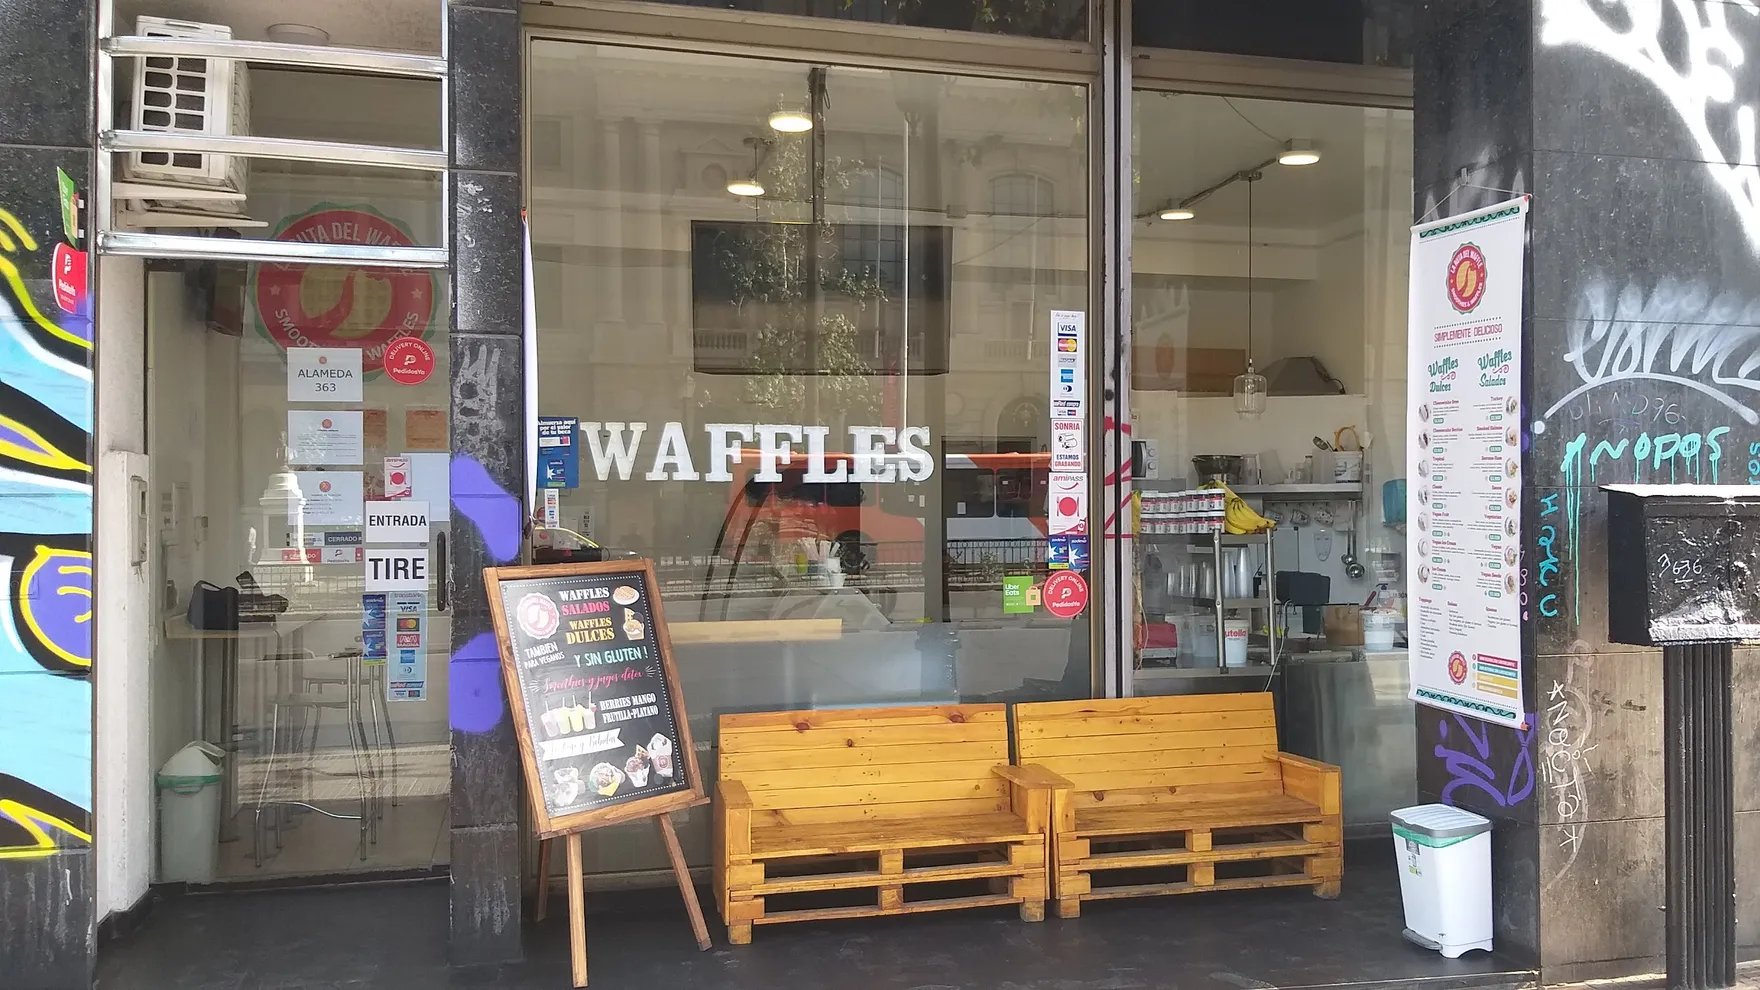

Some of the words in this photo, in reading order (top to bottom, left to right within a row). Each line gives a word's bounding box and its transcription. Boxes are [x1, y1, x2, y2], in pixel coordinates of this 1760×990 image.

[332, 222, 361, 241] DEL
[1060, 324, 1077, 332] VISA
[1433, 327, 1471, 342] SIMPLEMENTE
[1473, 323, 1503, 337] DELICIOSO
[389, 341, 412, 360] DELIVERY
[413, 342, 431, 361] ONLINE
[1477, 348, 1512, 371] Waffles
[297, 369, 353, 379] ALAMEDA
[393, 367, 425, 376] PedidosYa
[1427, 356, 1459, 378] Waffles
[315, 383, 336, 392] 363
[1429, 381, 1452, 393] Dulces
[1479, 373, 1506, 387] Salados
[1054, 422, 1081, 431] SONRIA
[580, 421, 935, 483] WAFFLES
[368, 515, 427, 527] ENTRADA
[368, 557, 426, 580] TIRE
[559, 586, 610, 602] WAFFLES
[1047, 575, 1068, 595] DELIVERY
[1068, 575, 1085, 593] ONLINE
[400, 605, 418, 613] VISA
[561, 600, 611, 616] SALADOS
[569, 616, 612, 631] WAFFLES
[565, 627, 615, 645] DULCES
[1224, 629, 1247, 638] utella
[523, 641, 559, 659] TAMBIEN
[574, 653, 581, 668] Y
[584, 651, 603, 667] SIN
[604, 646, 643, 664] GLUTEN
[523, 659, 539, 670] PARA
[540, 651, 566, 666] VEGANOS
[599, 696, 632, 711] BERRIES
[632, 692, 656, 706] MANGO
[602, 705, 659, 724] FRUTILLA-PLATANO
